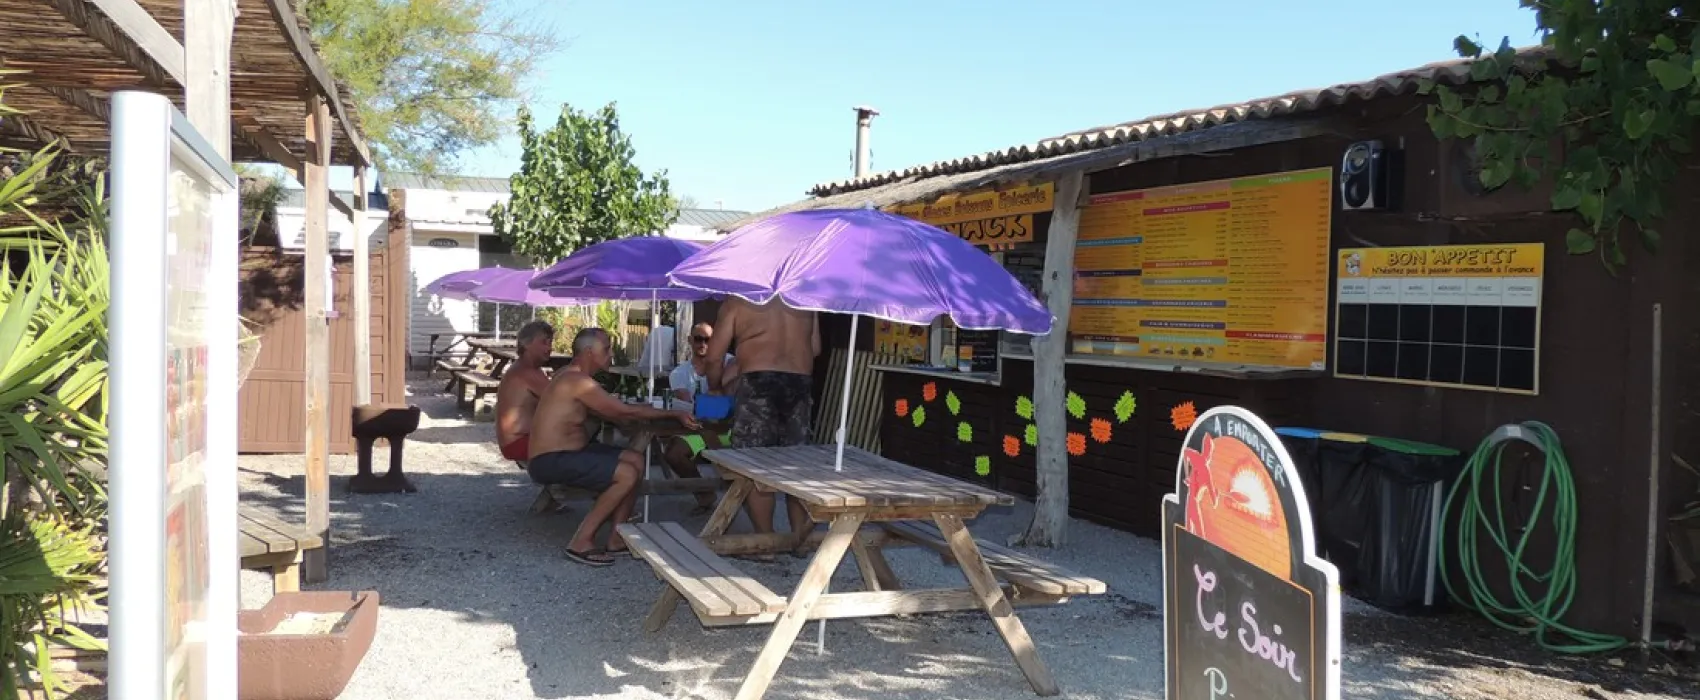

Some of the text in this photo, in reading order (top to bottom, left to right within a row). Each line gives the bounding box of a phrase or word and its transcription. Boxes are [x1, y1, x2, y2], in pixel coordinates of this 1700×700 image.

[943, 215, 1027, 240] NACK
[1387, 250, 1428, 266] BON
[1406, 268, 1419, 276] pas
[1455, 265, 1493, 274] commande
[1213, 415, 1286, 488] A EMPORTER
[1237, 601, 1302, 683] Soir
